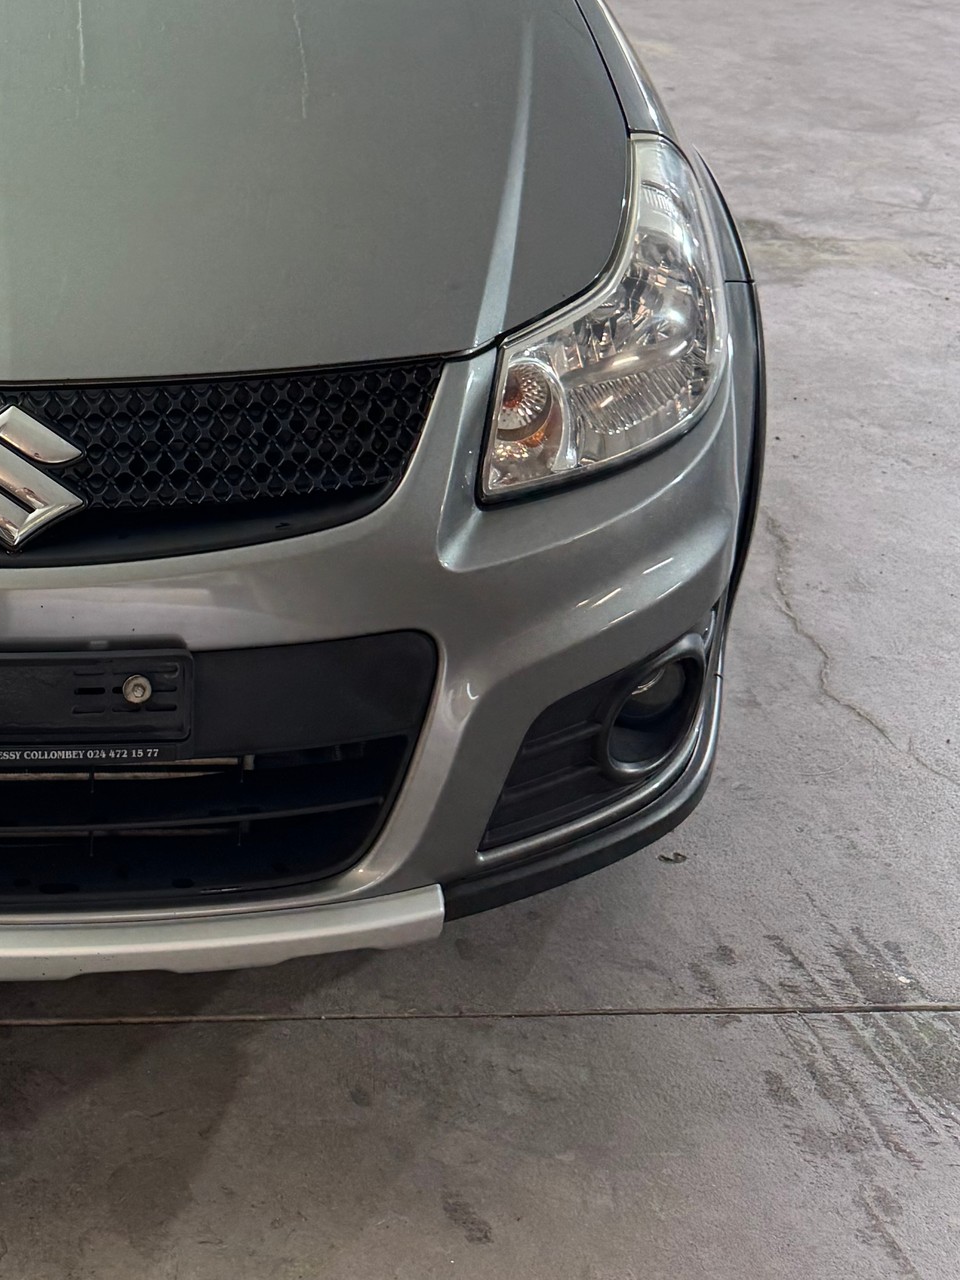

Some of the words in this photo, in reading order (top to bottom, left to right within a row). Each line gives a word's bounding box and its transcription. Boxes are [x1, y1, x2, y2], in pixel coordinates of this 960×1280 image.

[23, 749, 85, 760] COLLOMBEY
[87, 749, 107, 759] 024
[109, 748, 128, 758] 472
[131, 748, 144, 758] 15
[147, 748, 160, 758] 77
